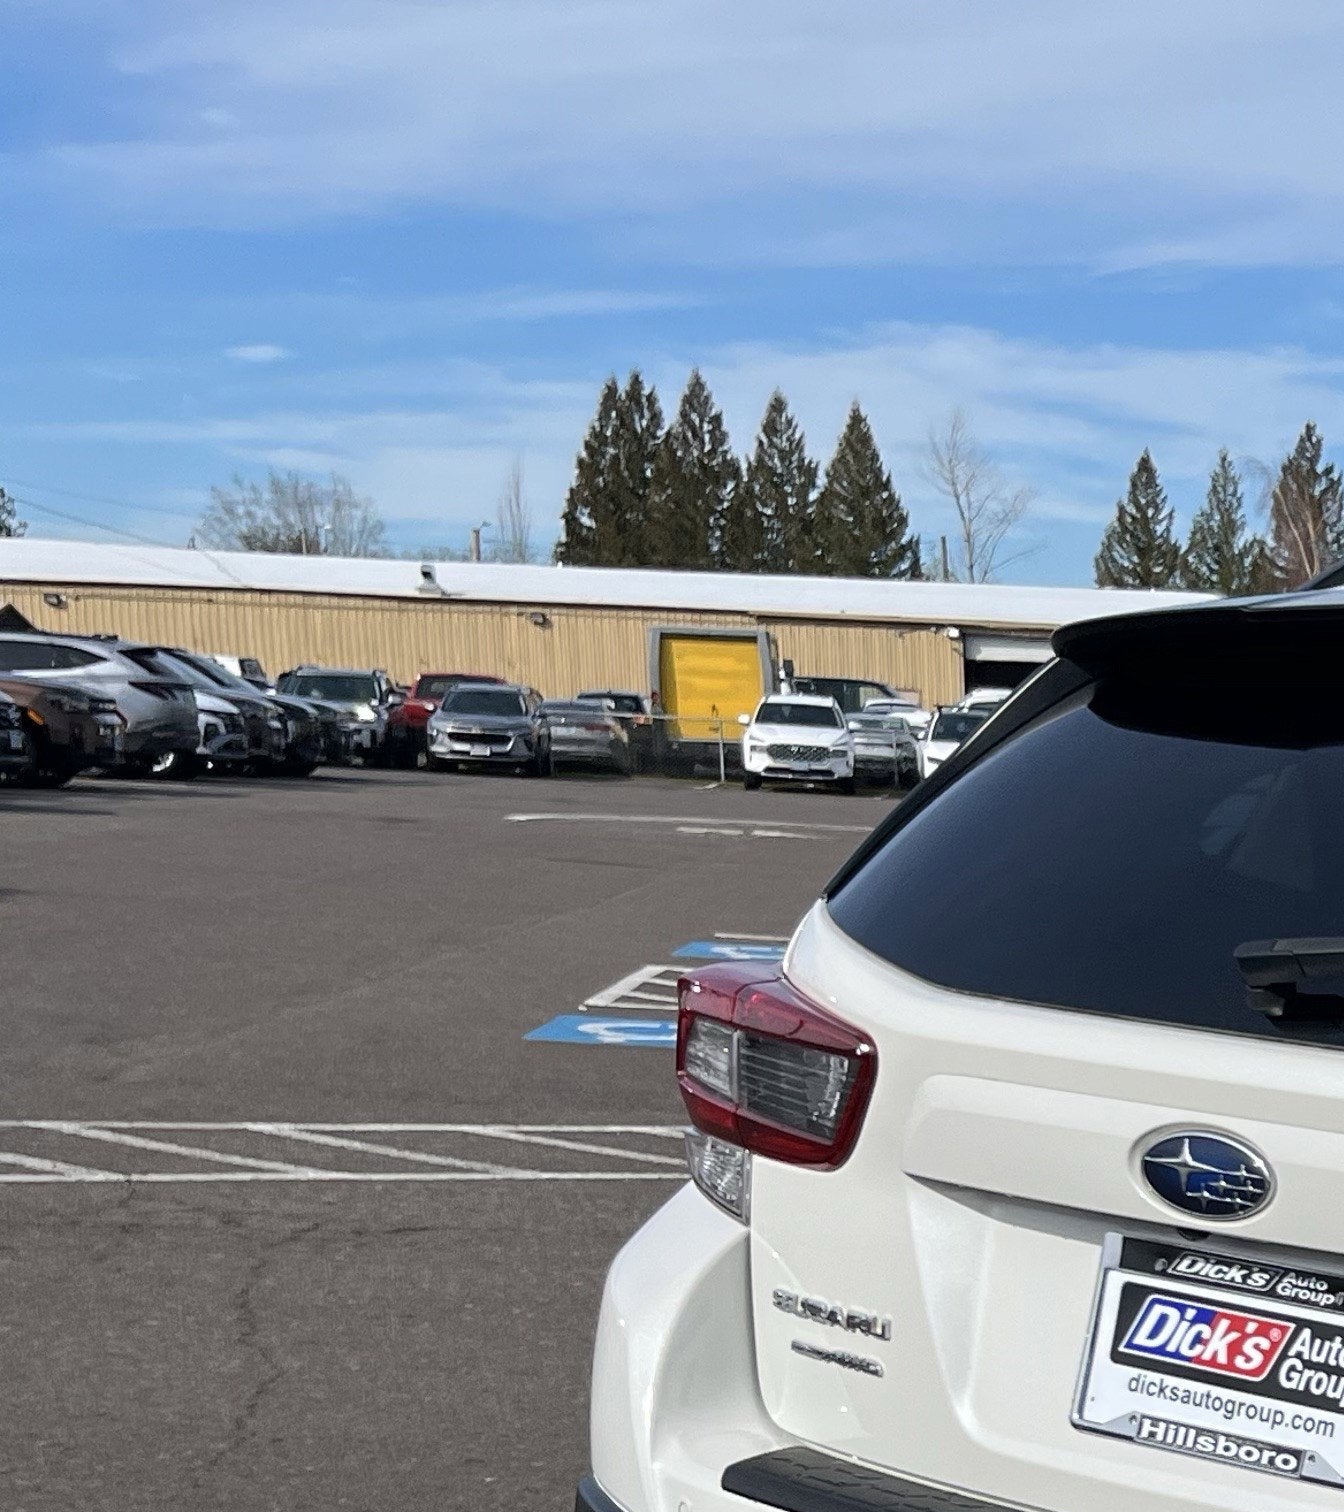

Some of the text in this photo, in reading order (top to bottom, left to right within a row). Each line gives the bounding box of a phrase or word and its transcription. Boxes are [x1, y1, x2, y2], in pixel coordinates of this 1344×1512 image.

[1176, 1253, 1272, 1289] Dick's
[1283, 1271, 1329, 1291] Auto
[1276, 1283, 1337, 1307] Group
[1133, 1303, 1271, 1371] Dick's
[1128, 1373, 1336, 1438] dicksautogroup.com
[1138, 1417, 1299, 1471] Hillsboro
